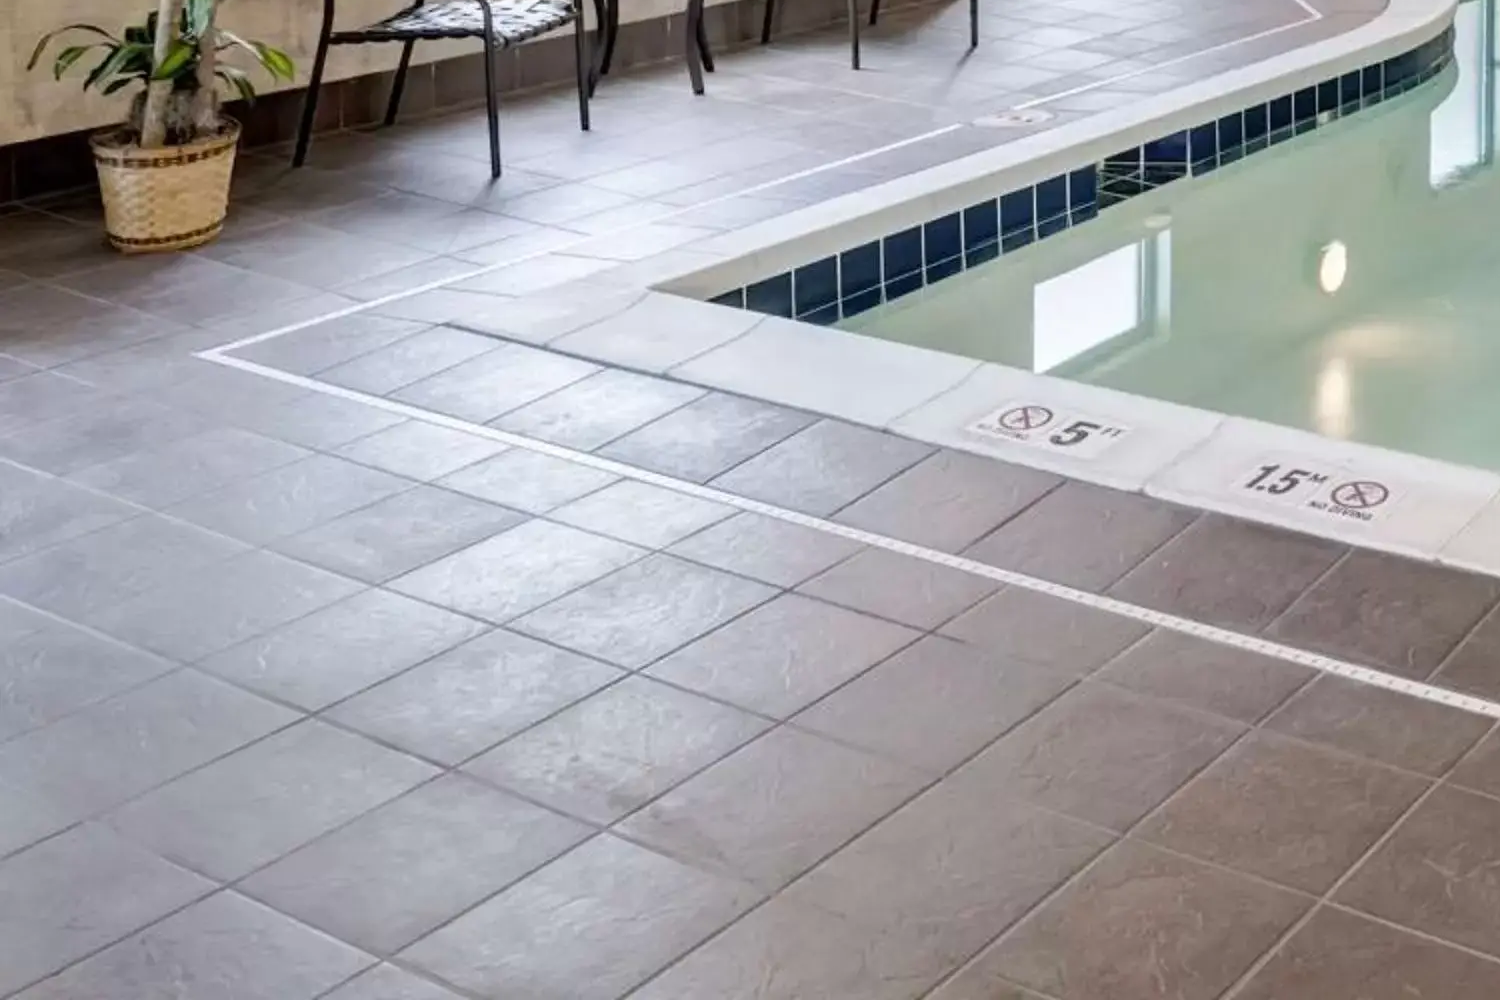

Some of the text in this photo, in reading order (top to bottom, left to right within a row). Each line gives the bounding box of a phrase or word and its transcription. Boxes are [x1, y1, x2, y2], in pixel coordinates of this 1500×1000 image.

[1049, 420, 1100, 445] 5
[1245, 464, 1328, 494] 1.5 M
